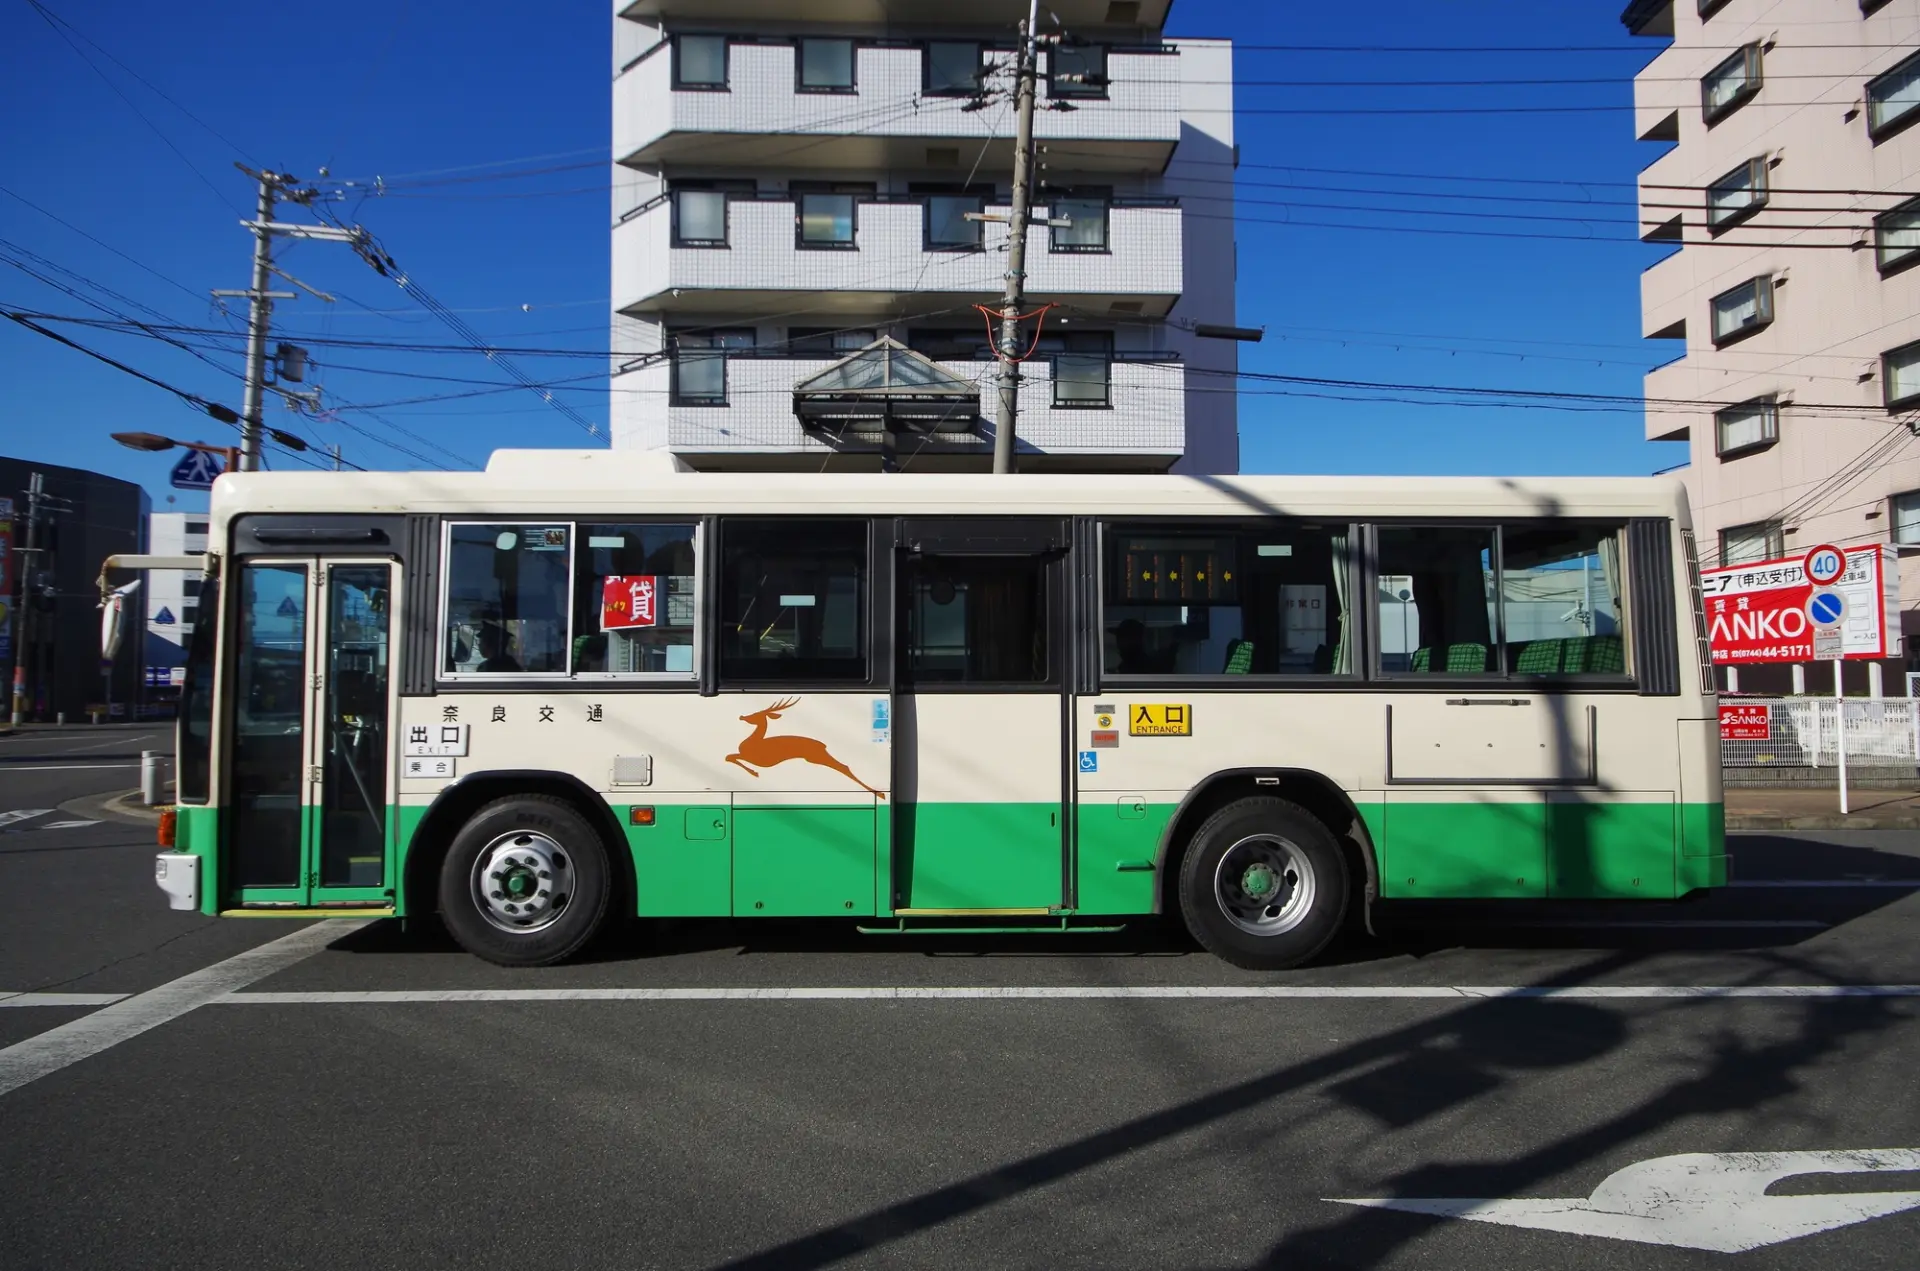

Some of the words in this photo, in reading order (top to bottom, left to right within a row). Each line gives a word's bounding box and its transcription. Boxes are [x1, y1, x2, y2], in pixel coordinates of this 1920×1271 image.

[1814, 555, 1837, 574] 40
[442, 704, 603, 723] 奈良交通
[1136, 706, 1183, 724] 入口
[1730, 715, 1767, 725] SANKO
[410, 726, 460, 744] 出口
[417, 746, 450, 754] EXIT
[410, 761, 448, 773] 乗合
